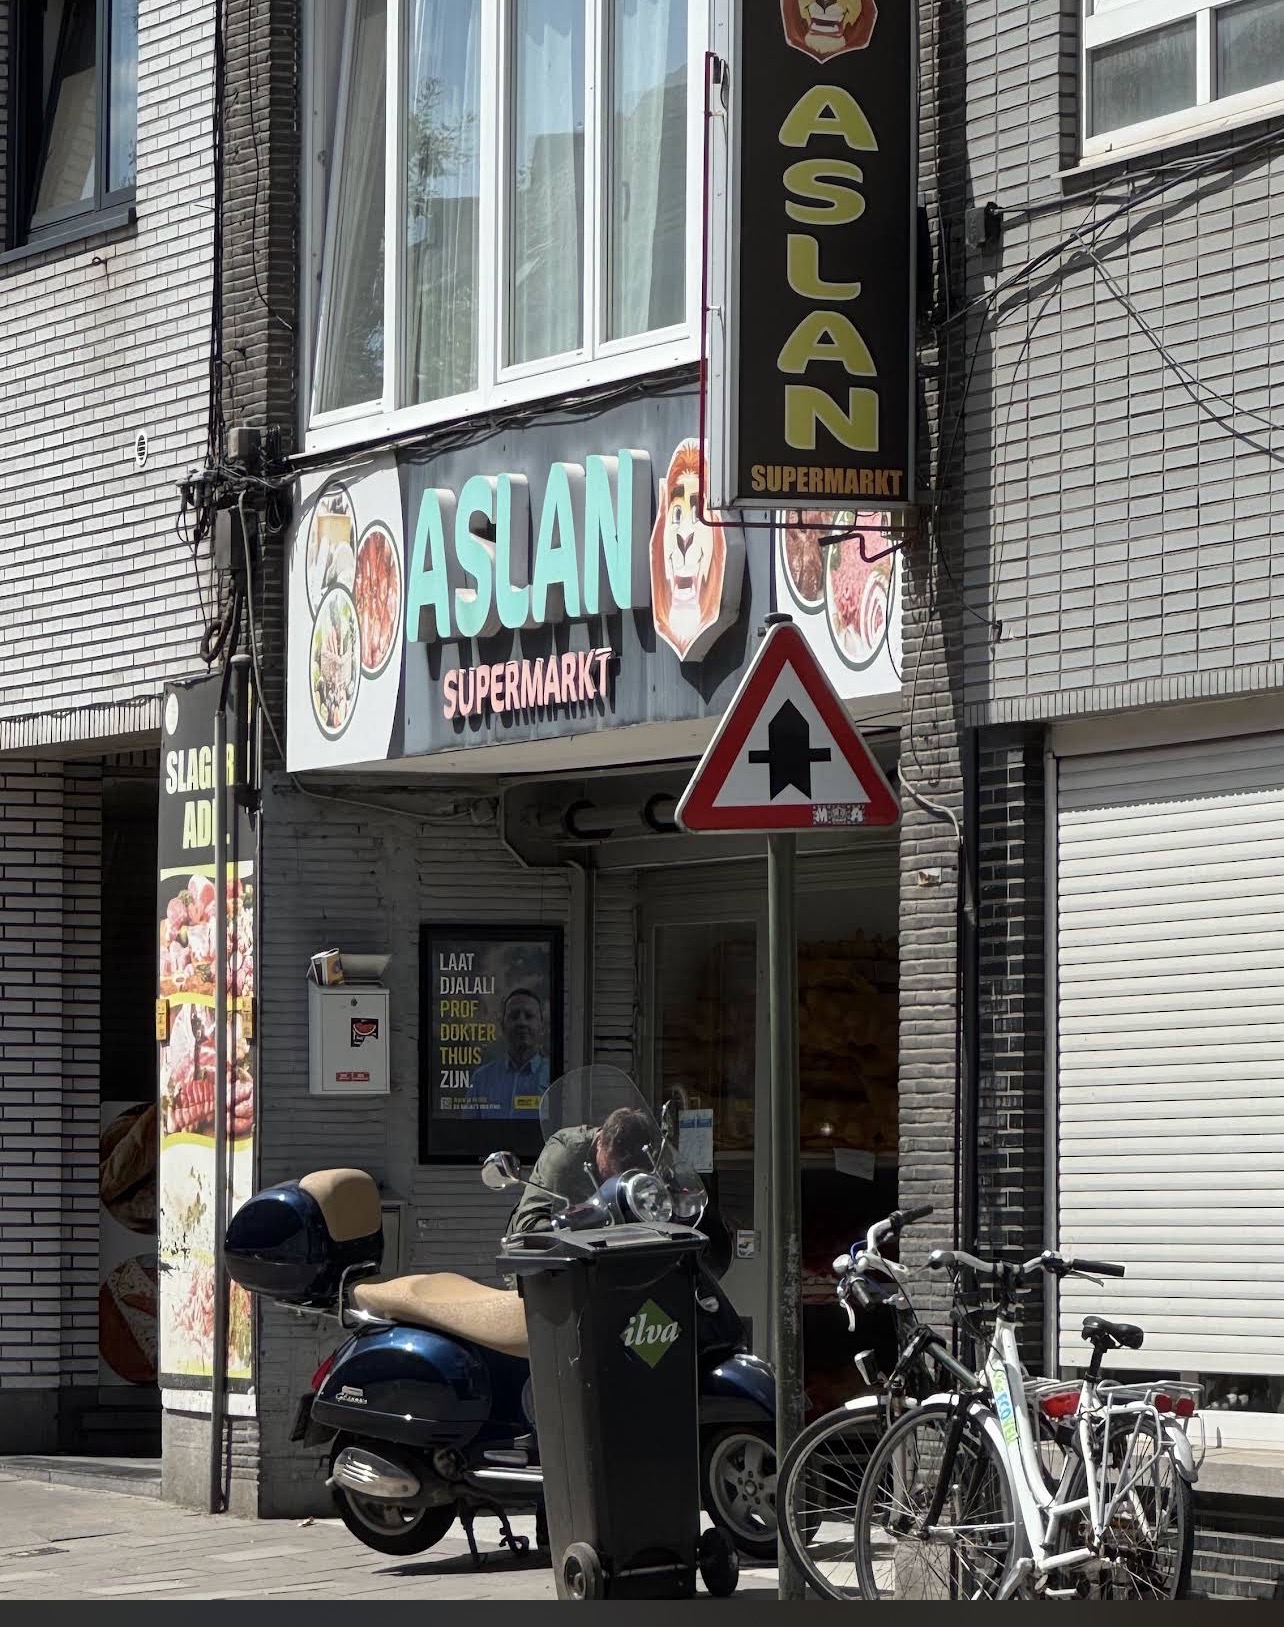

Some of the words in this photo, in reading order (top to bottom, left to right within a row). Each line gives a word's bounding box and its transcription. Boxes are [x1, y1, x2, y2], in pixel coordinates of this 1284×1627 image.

[777, 84, 879, 452] ASLAN
[751, 464, 904, 497] SUPERMARKT
[406, 448, 634, 643] ASLAN
[443, 647, 613, 720] SUPERMARKT
[439, 953, 475, 971] LAAT
[439, 976, 495, 995] DJALALI
[440, 1000, 480, 1018] PROF
[440, 1023, 497, 1042] DOKTER
[440, 1047, 482, 1065] THUIS
[439, 1070, 474, 1088] ZIJN.
[624, 1313, 679, 1346] ilva
